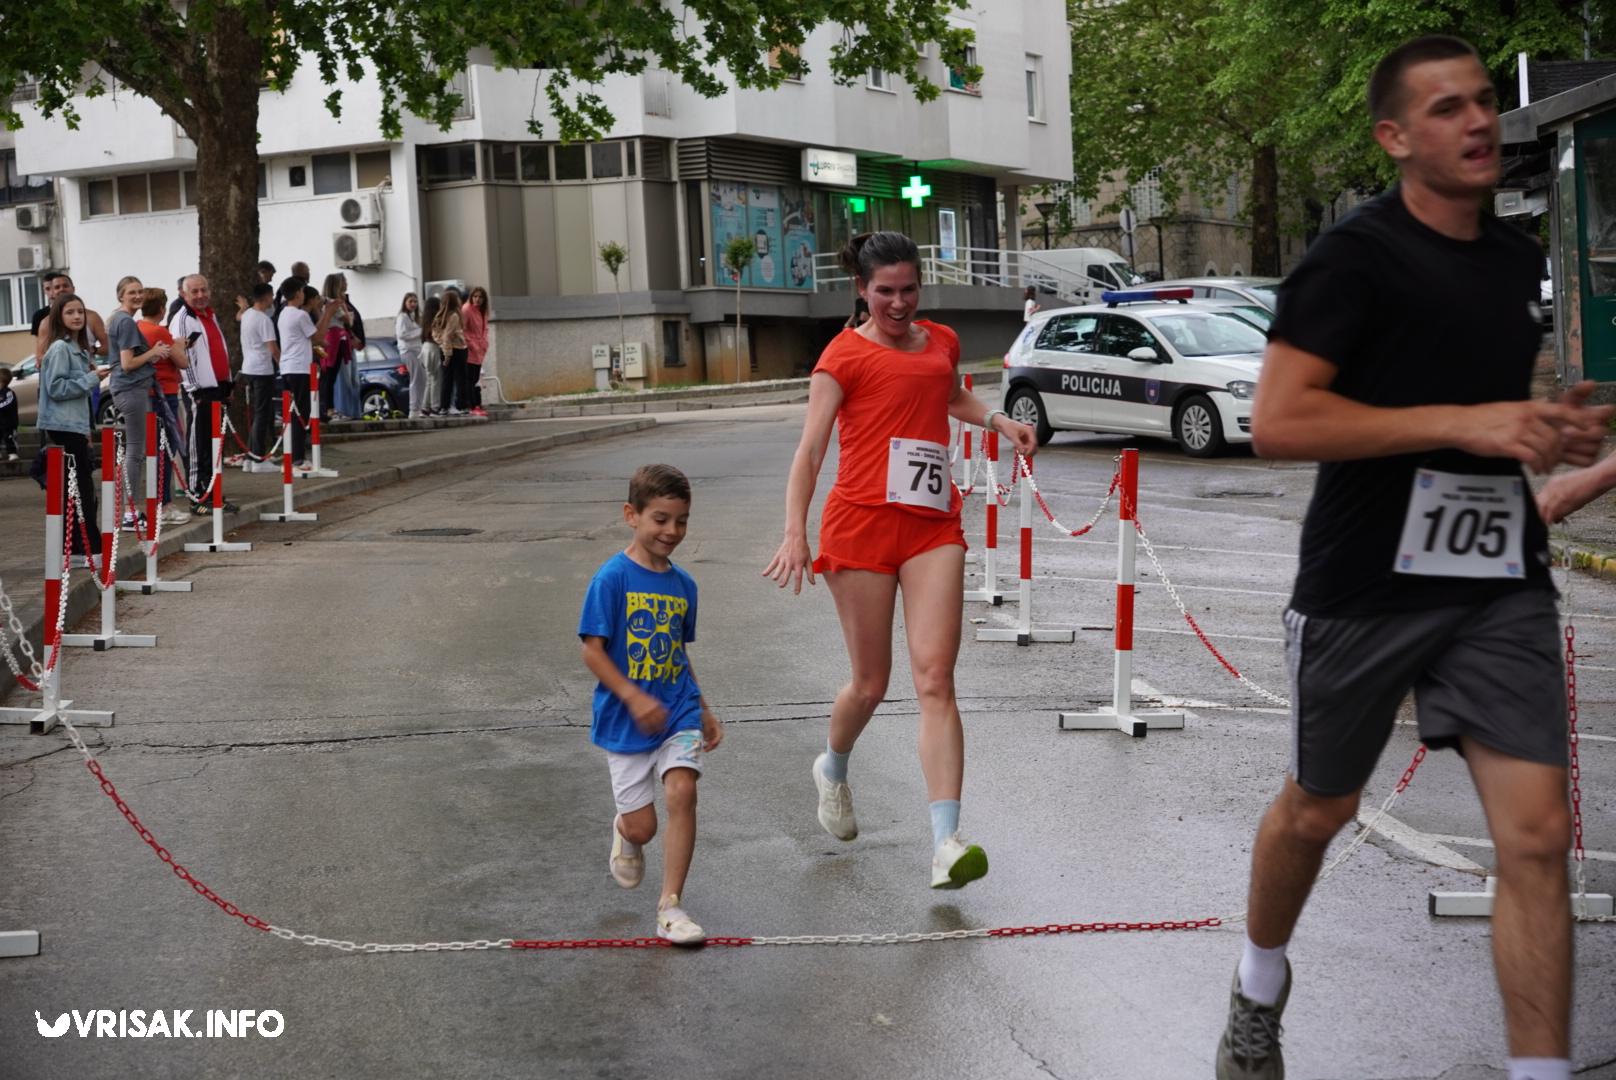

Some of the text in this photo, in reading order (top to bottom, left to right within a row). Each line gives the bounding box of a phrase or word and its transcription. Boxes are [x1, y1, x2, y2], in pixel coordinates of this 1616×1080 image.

[1061, 374, 1122, 397] POLICIJA
[908, 460, 942, 495] 75
[1422, 505, 1512, 558] 105
[626, 592, 689, 612] BETTER
